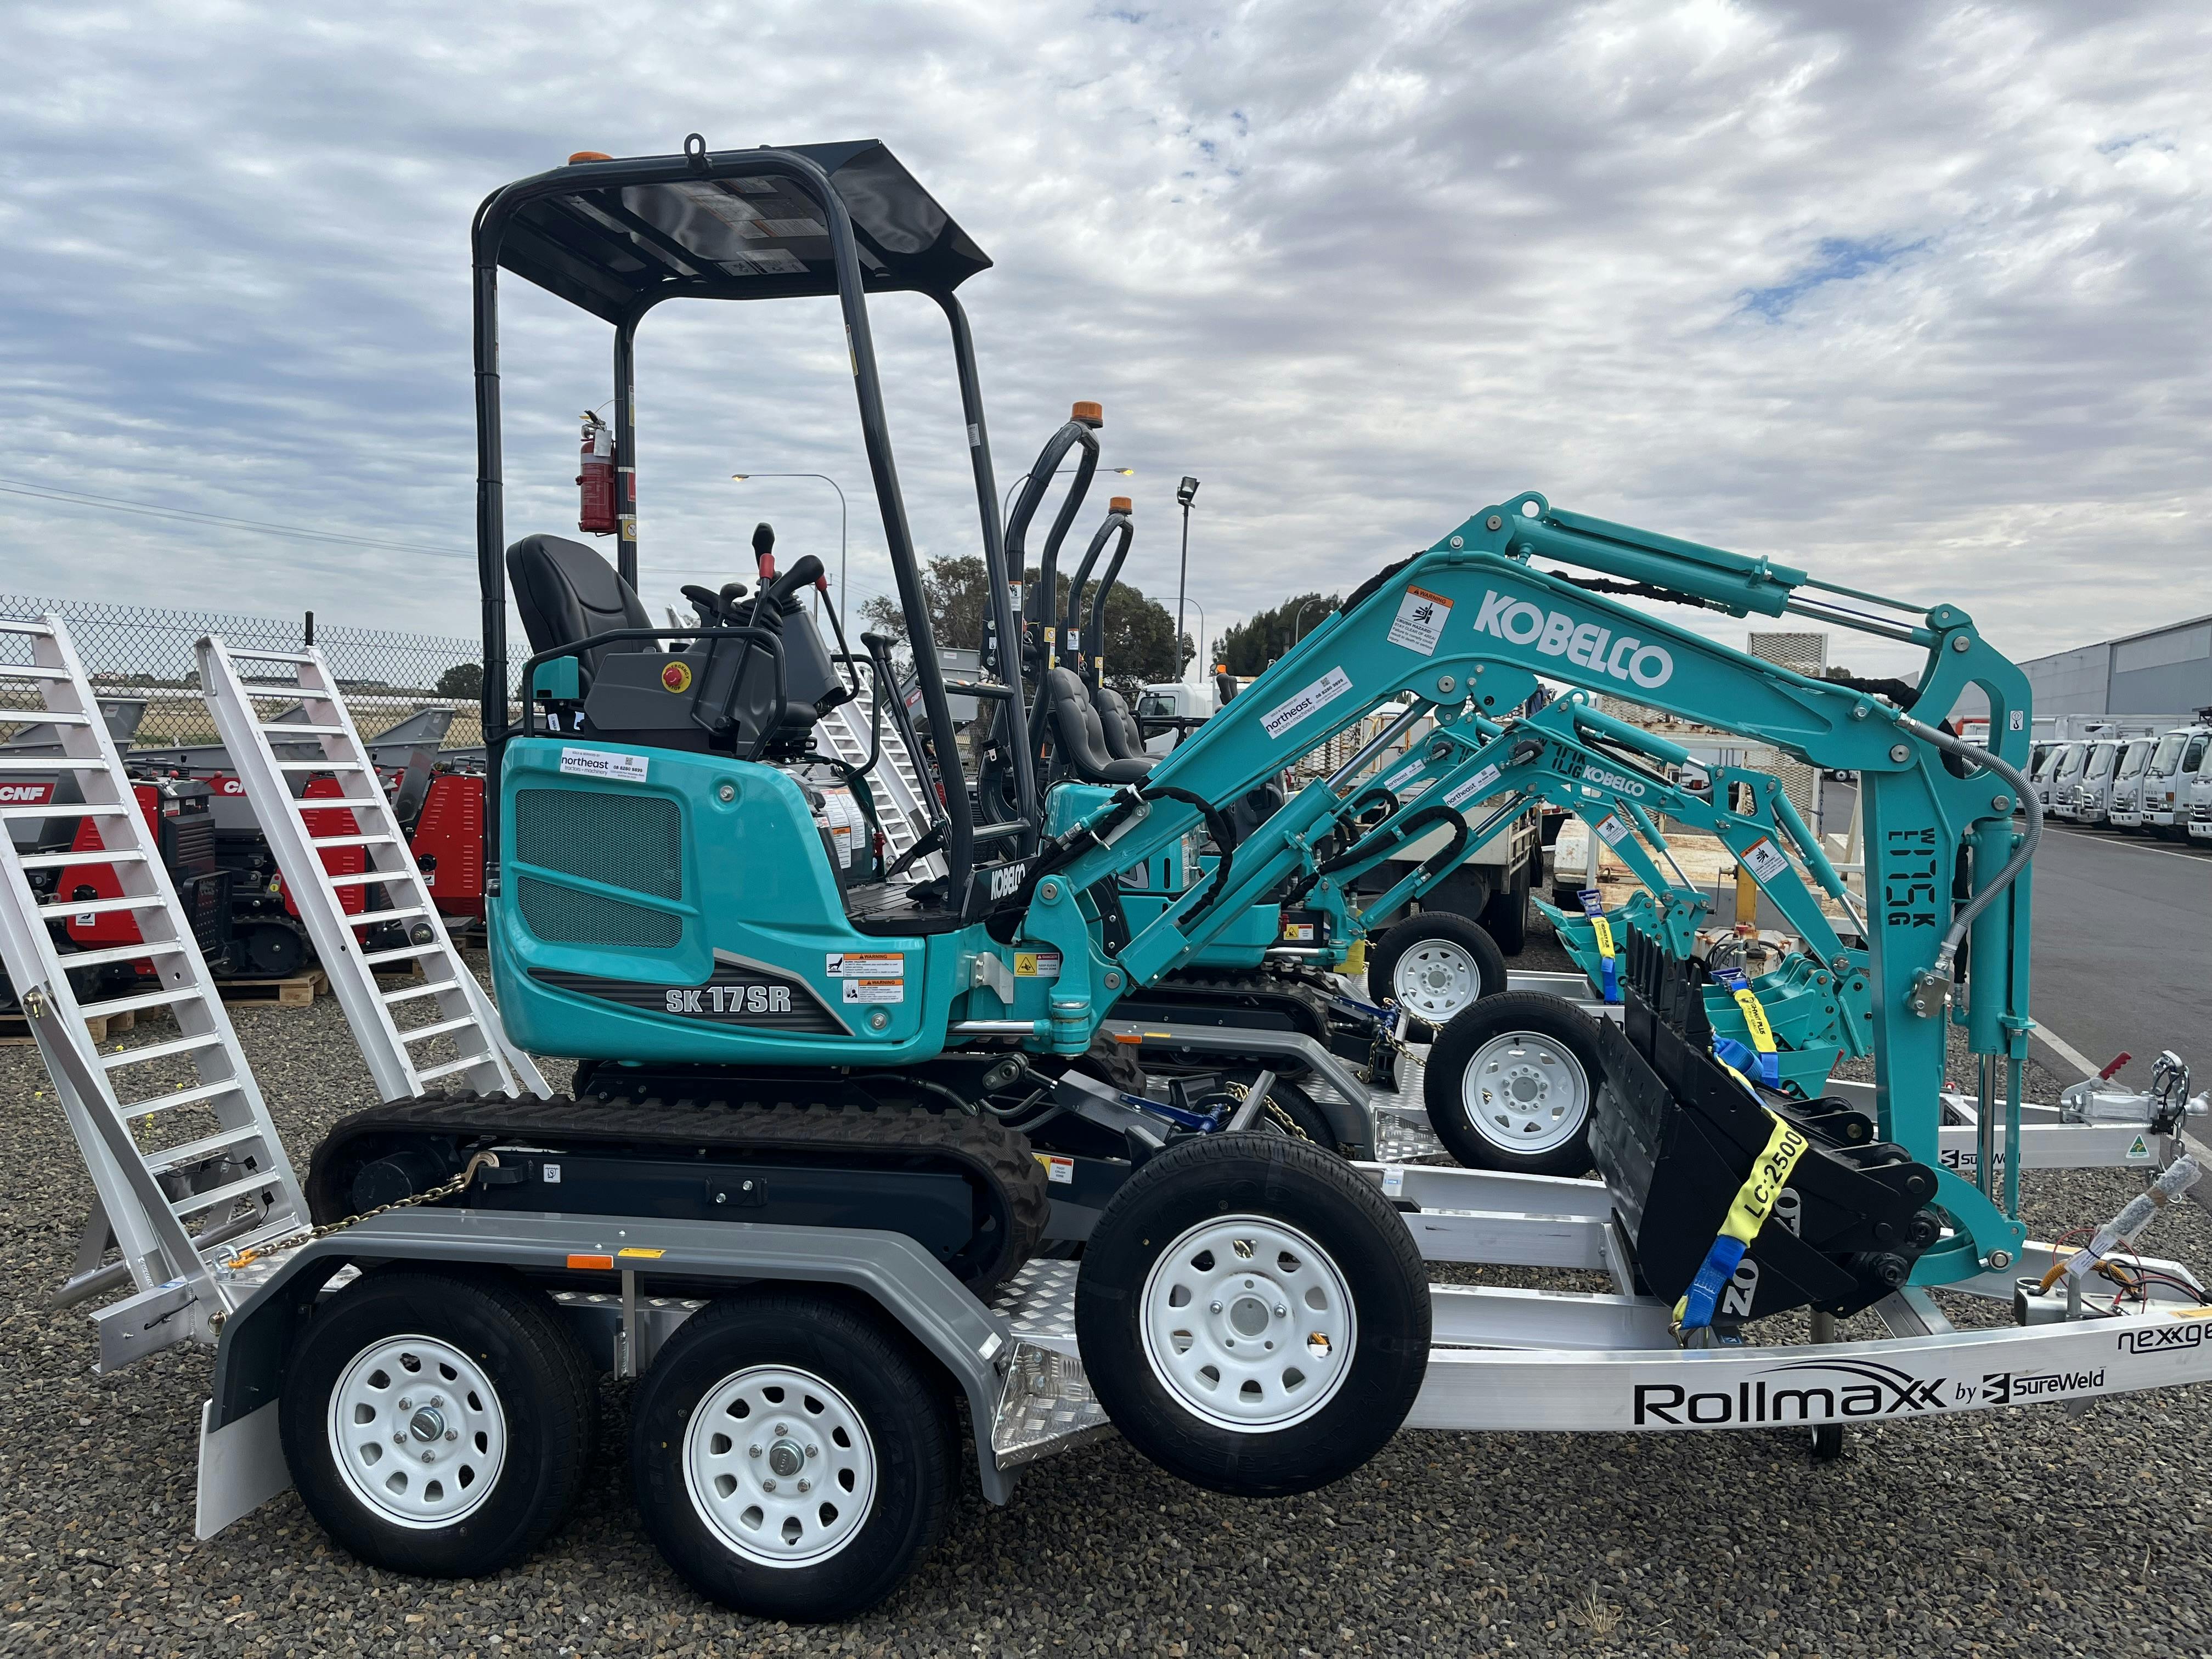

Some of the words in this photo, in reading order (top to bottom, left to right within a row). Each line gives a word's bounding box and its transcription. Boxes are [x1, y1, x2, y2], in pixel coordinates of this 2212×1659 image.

[1420, 590, 1446, 604] WARNING
[1396, 618, 1412, 627] CRUSH
[1473, 589, 1673, 689] KOBELCO
[670, 664, 690, 680] ERGENCY
[1265, 697, 1312, 732] northeast
[1273, 720, 1291, 734] tractors
[1293, 704, 1316, 722] machinery
[561, 757, 608, 769] northeast
[584, 768, 608, 776] machinery
[1386, 772, 1408, 788] northeast
[1582, 765, 1645, 797] KOBELCO
[0, 786, 45, 801] CNF
[1446, 783, 1476, 805] northeast
[990, 863, 1025, 900] KOBELCO
[1886, 849, 1936, 906] 175
[1743, 1130, 1802, 1219] LC:2500
[1634, 1369, 1948, 1425] Rollmaxx
[1955, 1382, 1977, 1404] by
[2013, 1369, 2104, 1396] SureWeld
